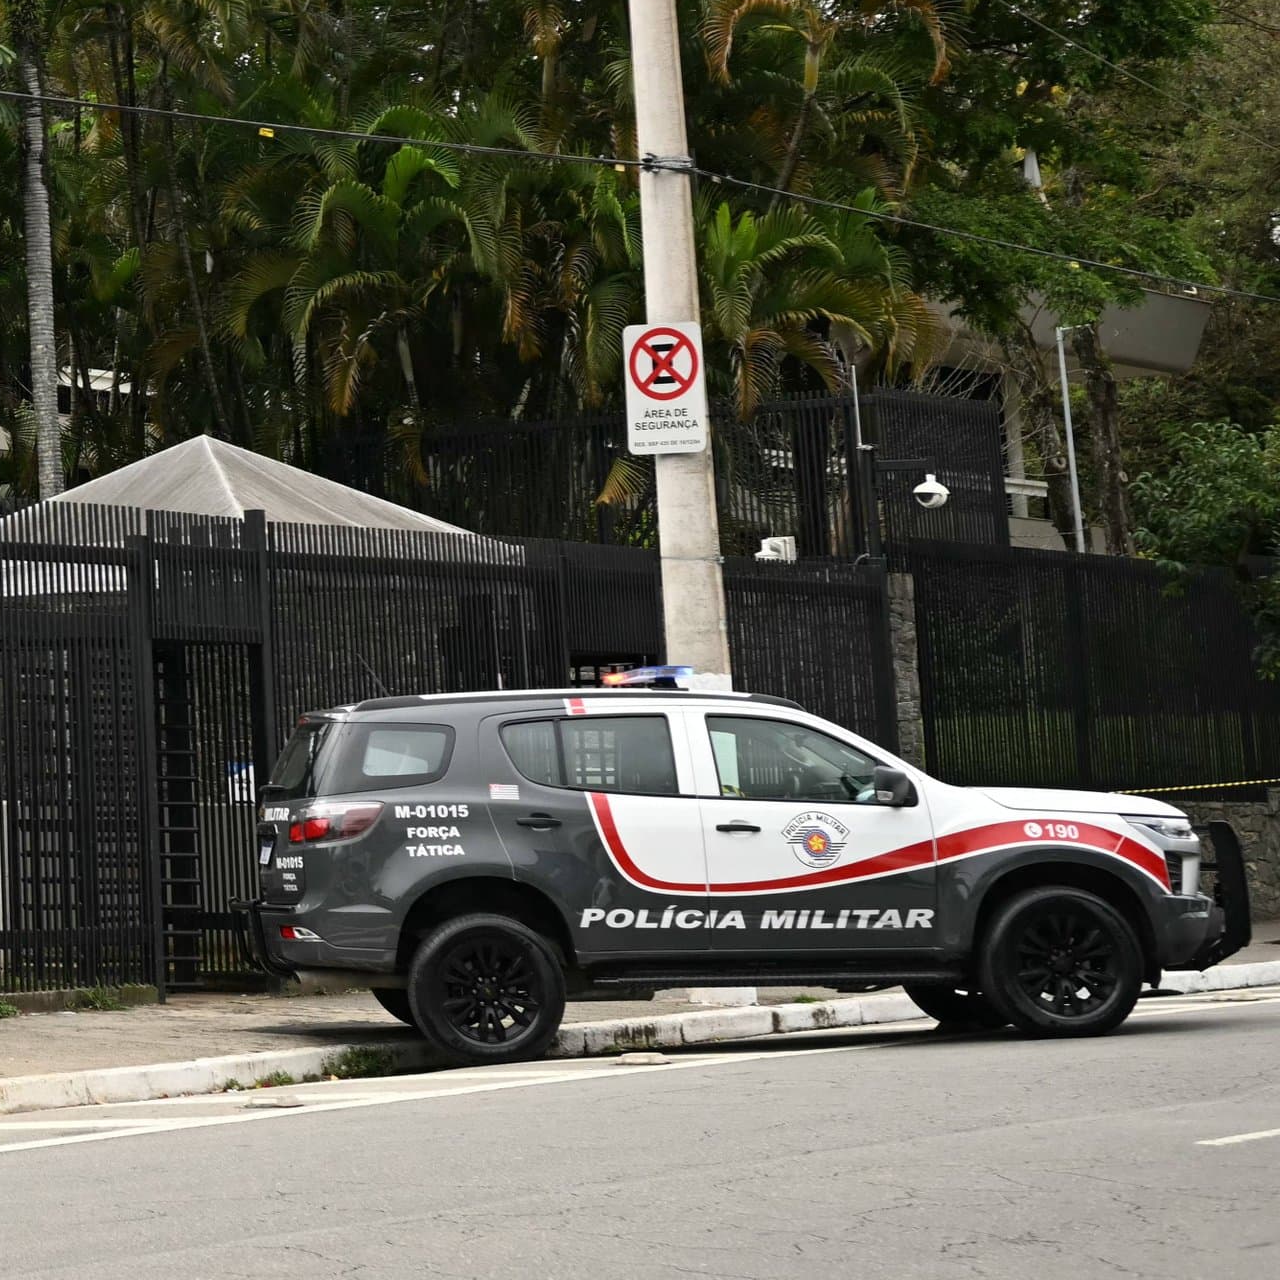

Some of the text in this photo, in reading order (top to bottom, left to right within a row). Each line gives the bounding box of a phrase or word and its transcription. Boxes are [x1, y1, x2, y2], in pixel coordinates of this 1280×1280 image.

[644, 408, 688, 418] ÁREA DE
[634, 420, 699, 431] SEGURANÇA
[394, 804, 469, 818] M-01015
[816, 814, 846, 835] MILITAR
[1044, 823, 1079, 839] 190
[406, 826, 461, 840] FORÇA
[405, 843, 465, 857] TÁTICA
[579, 905, 935, 929] POLÍCIA MILITAR
